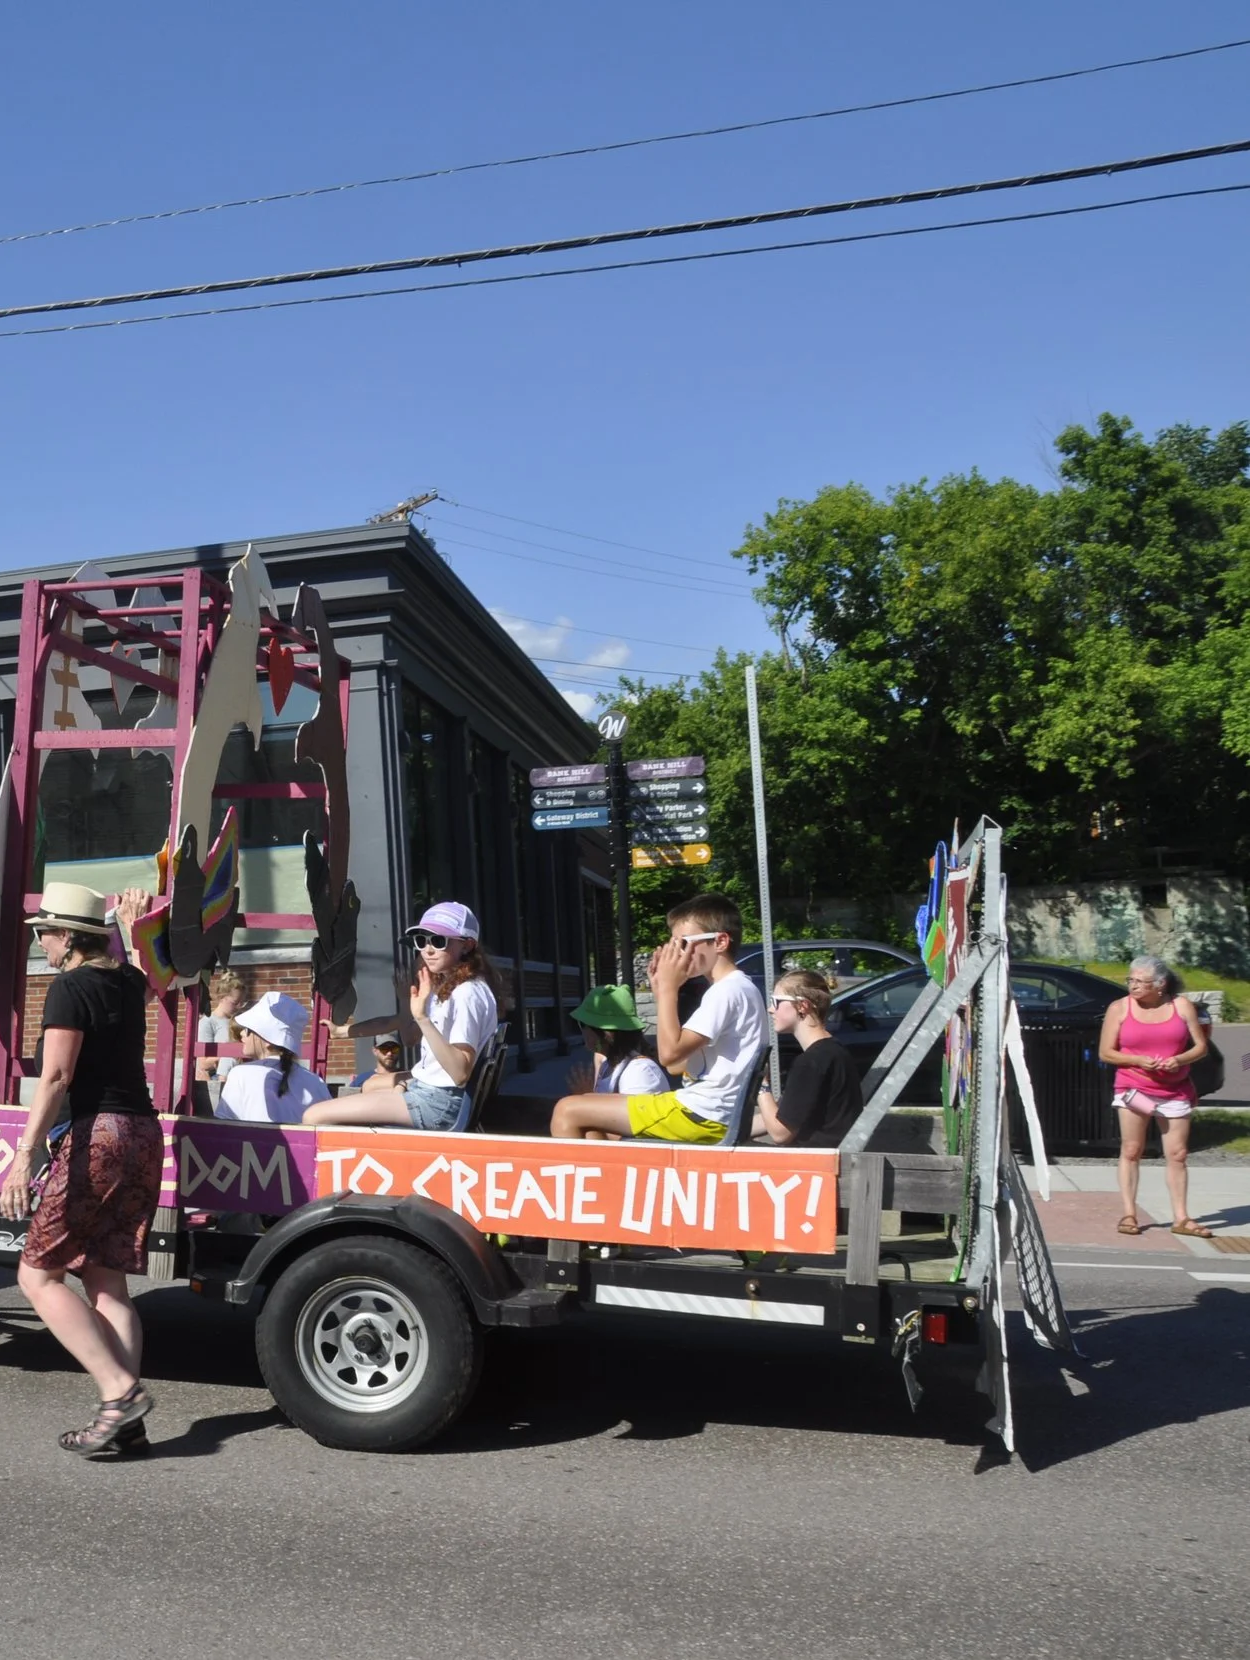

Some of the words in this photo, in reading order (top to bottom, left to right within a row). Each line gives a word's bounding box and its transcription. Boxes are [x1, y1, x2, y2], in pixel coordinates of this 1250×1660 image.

[598, 715, 627, 739] W
[667, 761, 687, 769] HILL
[571, 768, 591, 776] HILL
[649, 783, 680, 791] Shopping
[545, 789, 576, 798] Shopping
[664, 803, 687, 811] Parker
[546, 814, 575, 822] Gateway
[575, 812, 599, 820] District
[678, 810, 693, 819] Park
[316, 1148, 394, 1196] TO
[412, 1153, 606, 1224] CREATE
[620, 1166, 824, 1241] UNITY!
